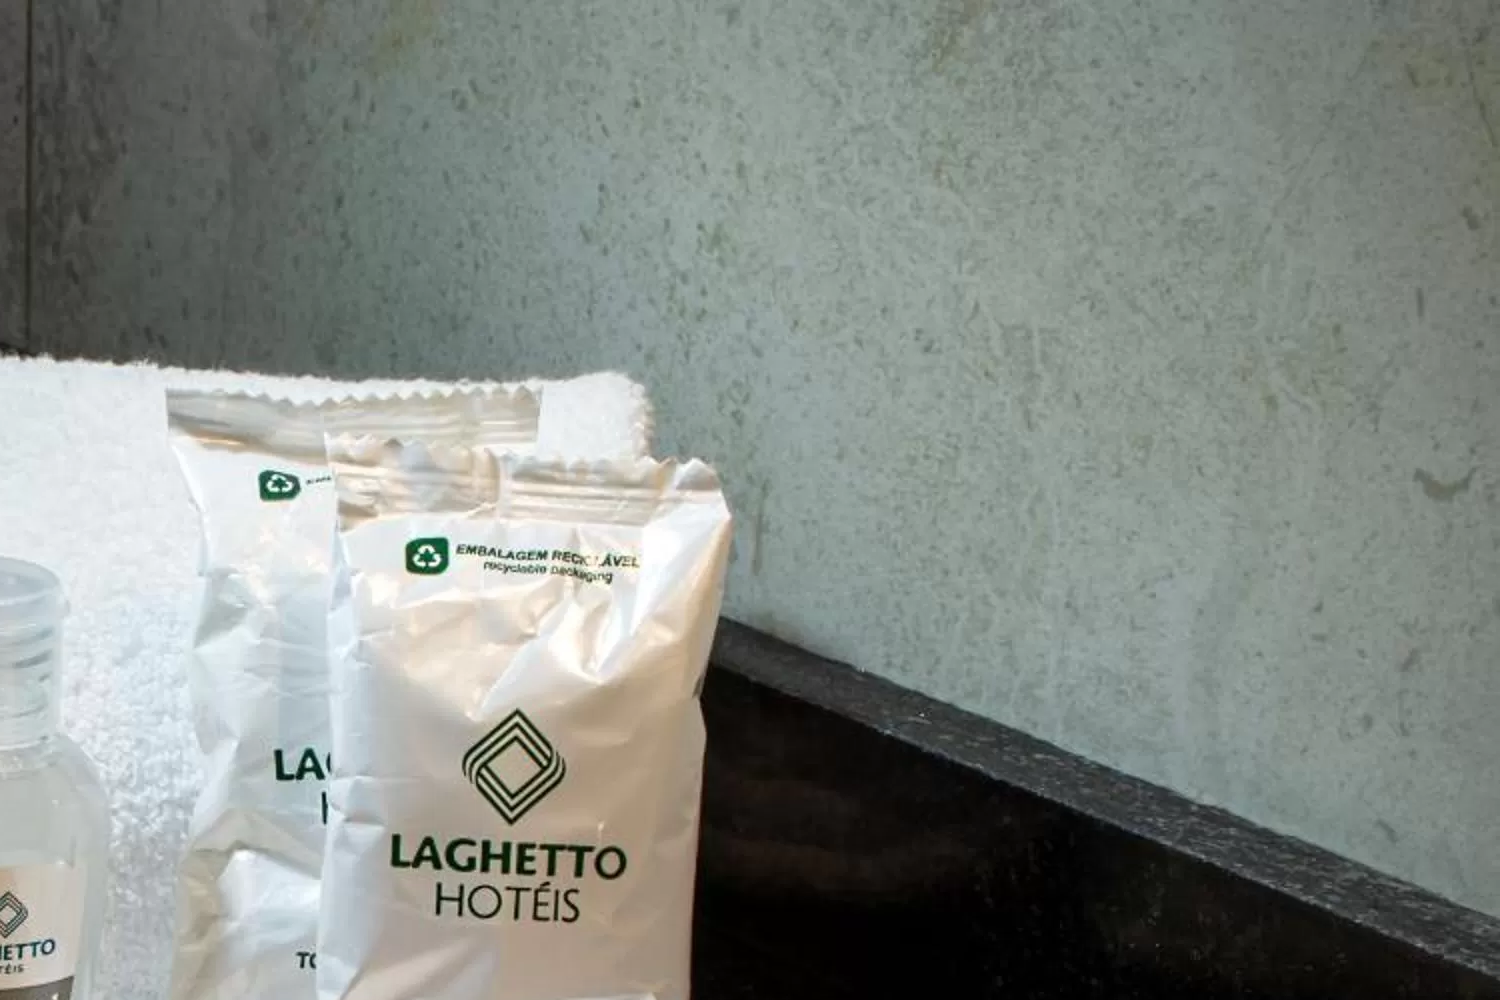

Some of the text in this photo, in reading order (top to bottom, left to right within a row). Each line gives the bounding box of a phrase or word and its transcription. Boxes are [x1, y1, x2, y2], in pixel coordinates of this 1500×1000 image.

[455, 543, 549, 561] EMBALAGEM
[483, 560, 614, 585] recyclable packaging
[390, 833, 627, 881] LAGHETTO
[435, 881, 581, 923] HOTÉIS
